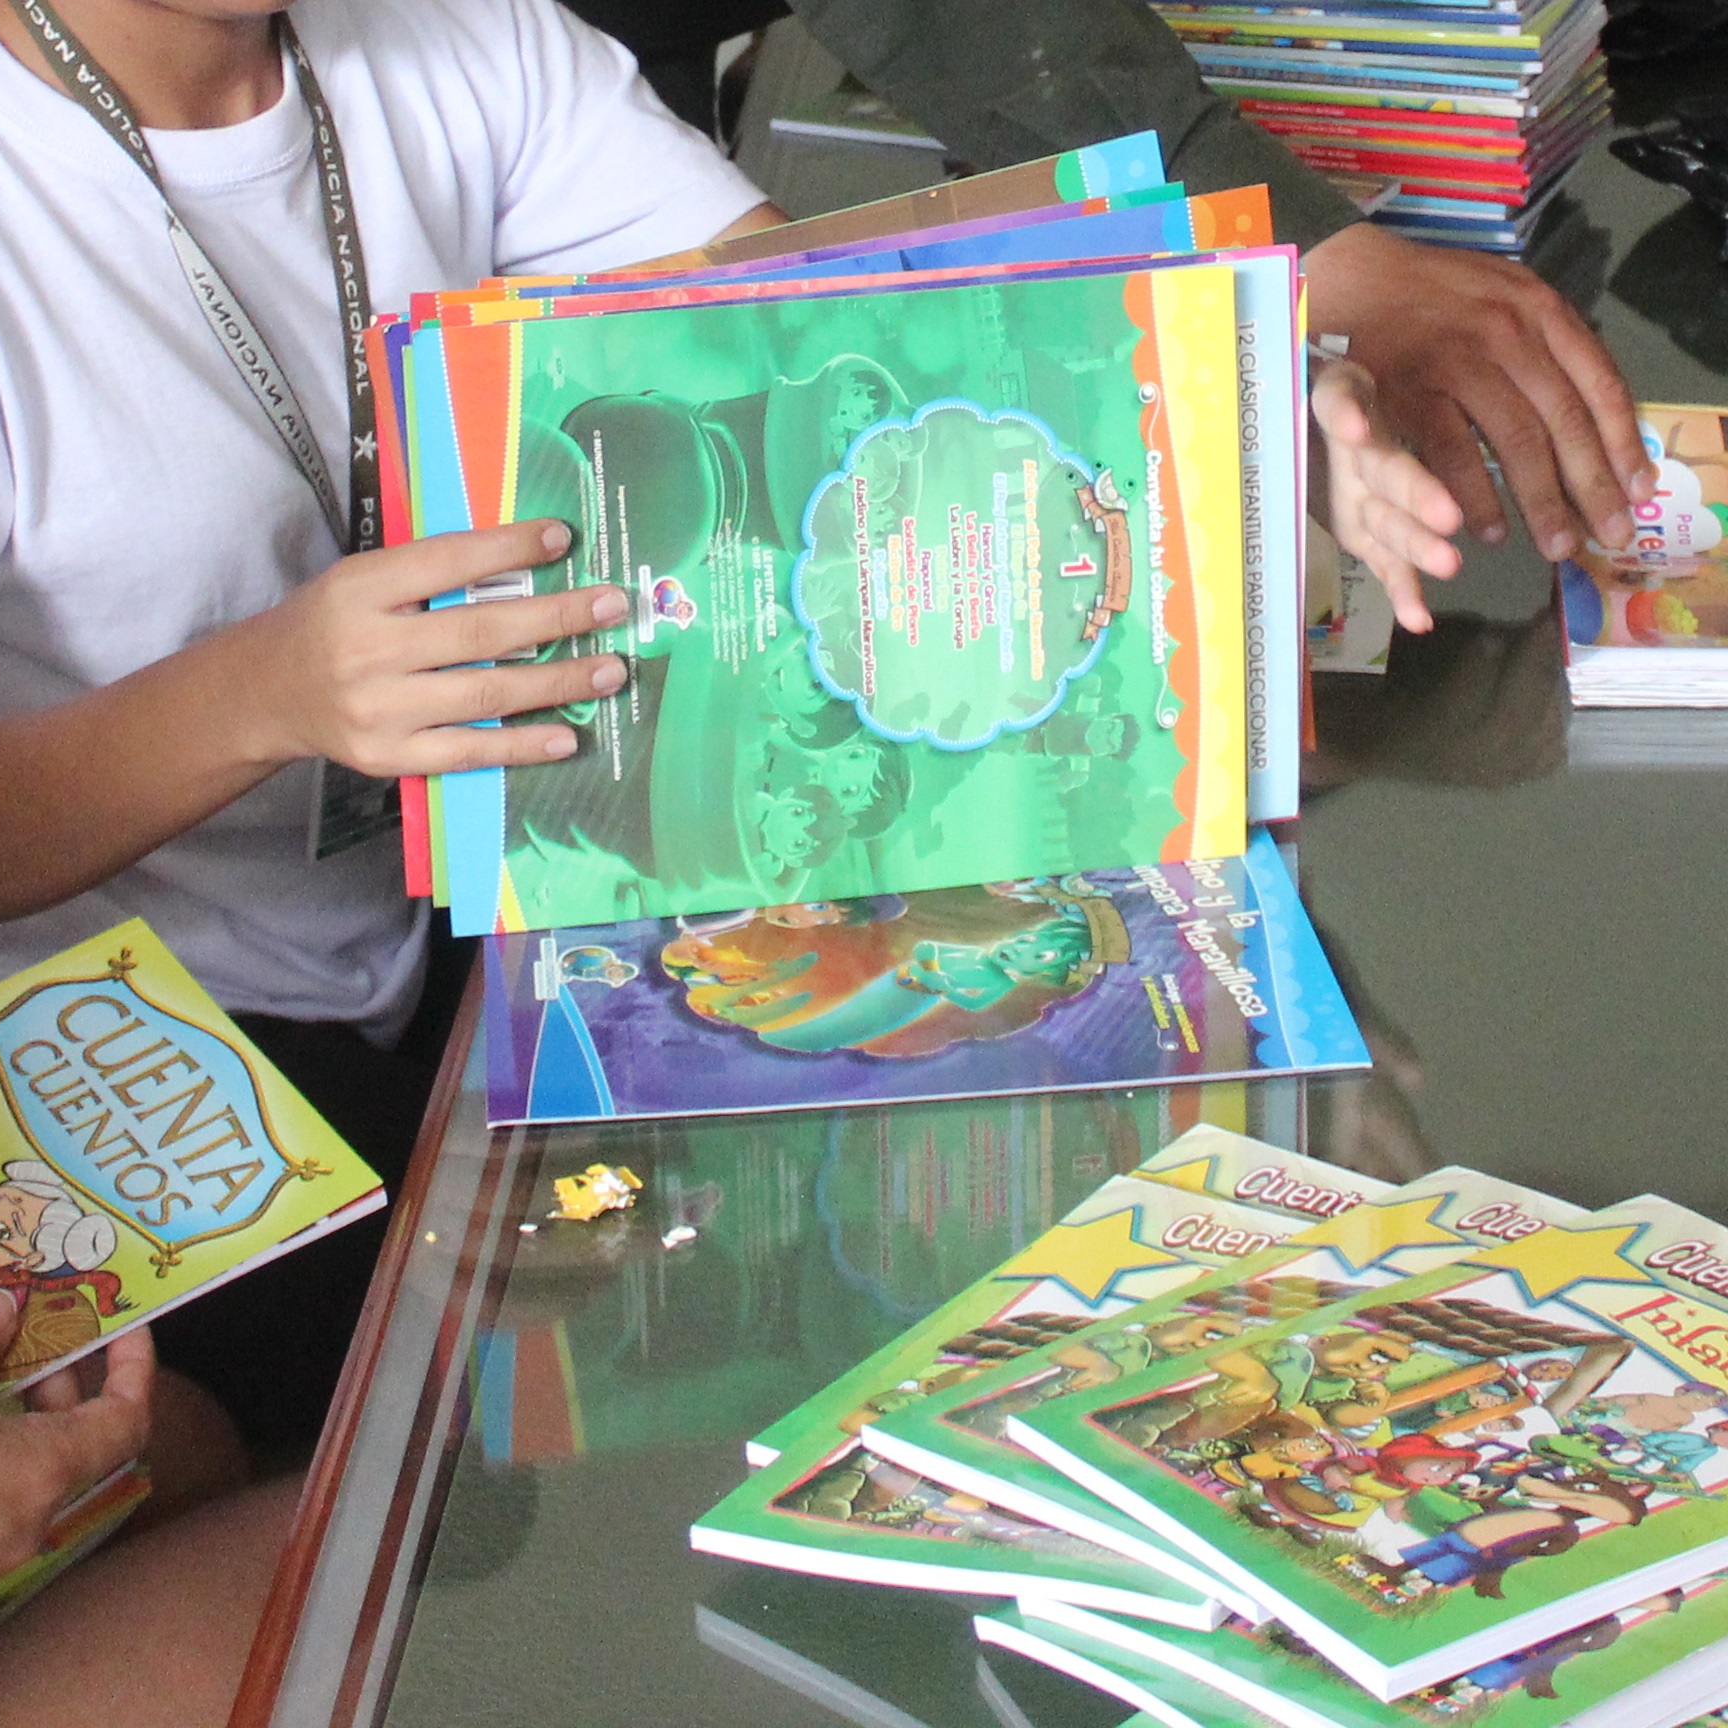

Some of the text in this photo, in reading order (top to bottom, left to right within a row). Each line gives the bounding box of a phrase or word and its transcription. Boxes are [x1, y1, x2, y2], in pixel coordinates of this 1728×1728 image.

[314, 105, 370, 397] POLICIA NACIONAL
[855, 478, 867, 529] Aladino
[950, 506, 960, 522] La
[965, 513, 976, 530] La
[858, 543, 870, 555] la
[951, 527, 963, 568] Liebre
[966, 534, 978, 568] Bella
[982, 525, 994, 570] Hansel
[1061, 556, 1096, 576] 1
[1144, 450, 1168, 664] Completa tu colección
[1238, 322, 1267, 770] 12 CLÁSICOS INFANTILES PARA COLECCIONAR
[763, 550, 777, 637] LE PETIT POUCET
[857, 559, 871, 616] Lámpara
[904, 518, 919, 646] Soldadito de Plomo
[920, 551, 932, 610] Rapunzel
[953, 583, 963, 595] la
[968, 582, 980, 594] la
[984, 585, 995, 624] Gretel
[594, 439, 604, 473] MUNDO
[599, 534, 609, 578] EDITORIAL
[613, 741, 622, 781] Colombia
[953, 601, 965, 649] Tortuga
[969, 598, 982, 640] Bestia
[862, 620, 875, 694] Maravillosa
[1191, 894, 1237, 908] y
[1226, 909, 1261, 929] la
[1125, 865, 1268, 1018] mpara Maravillosa
[55, 994, 266, 1216] CUENTA
[9, 1038, 194, 1228] CUENTOS
[1234, 1165, 1365, 1218] Cuent
[1161, 1213, 1289, 1257] Cuen
